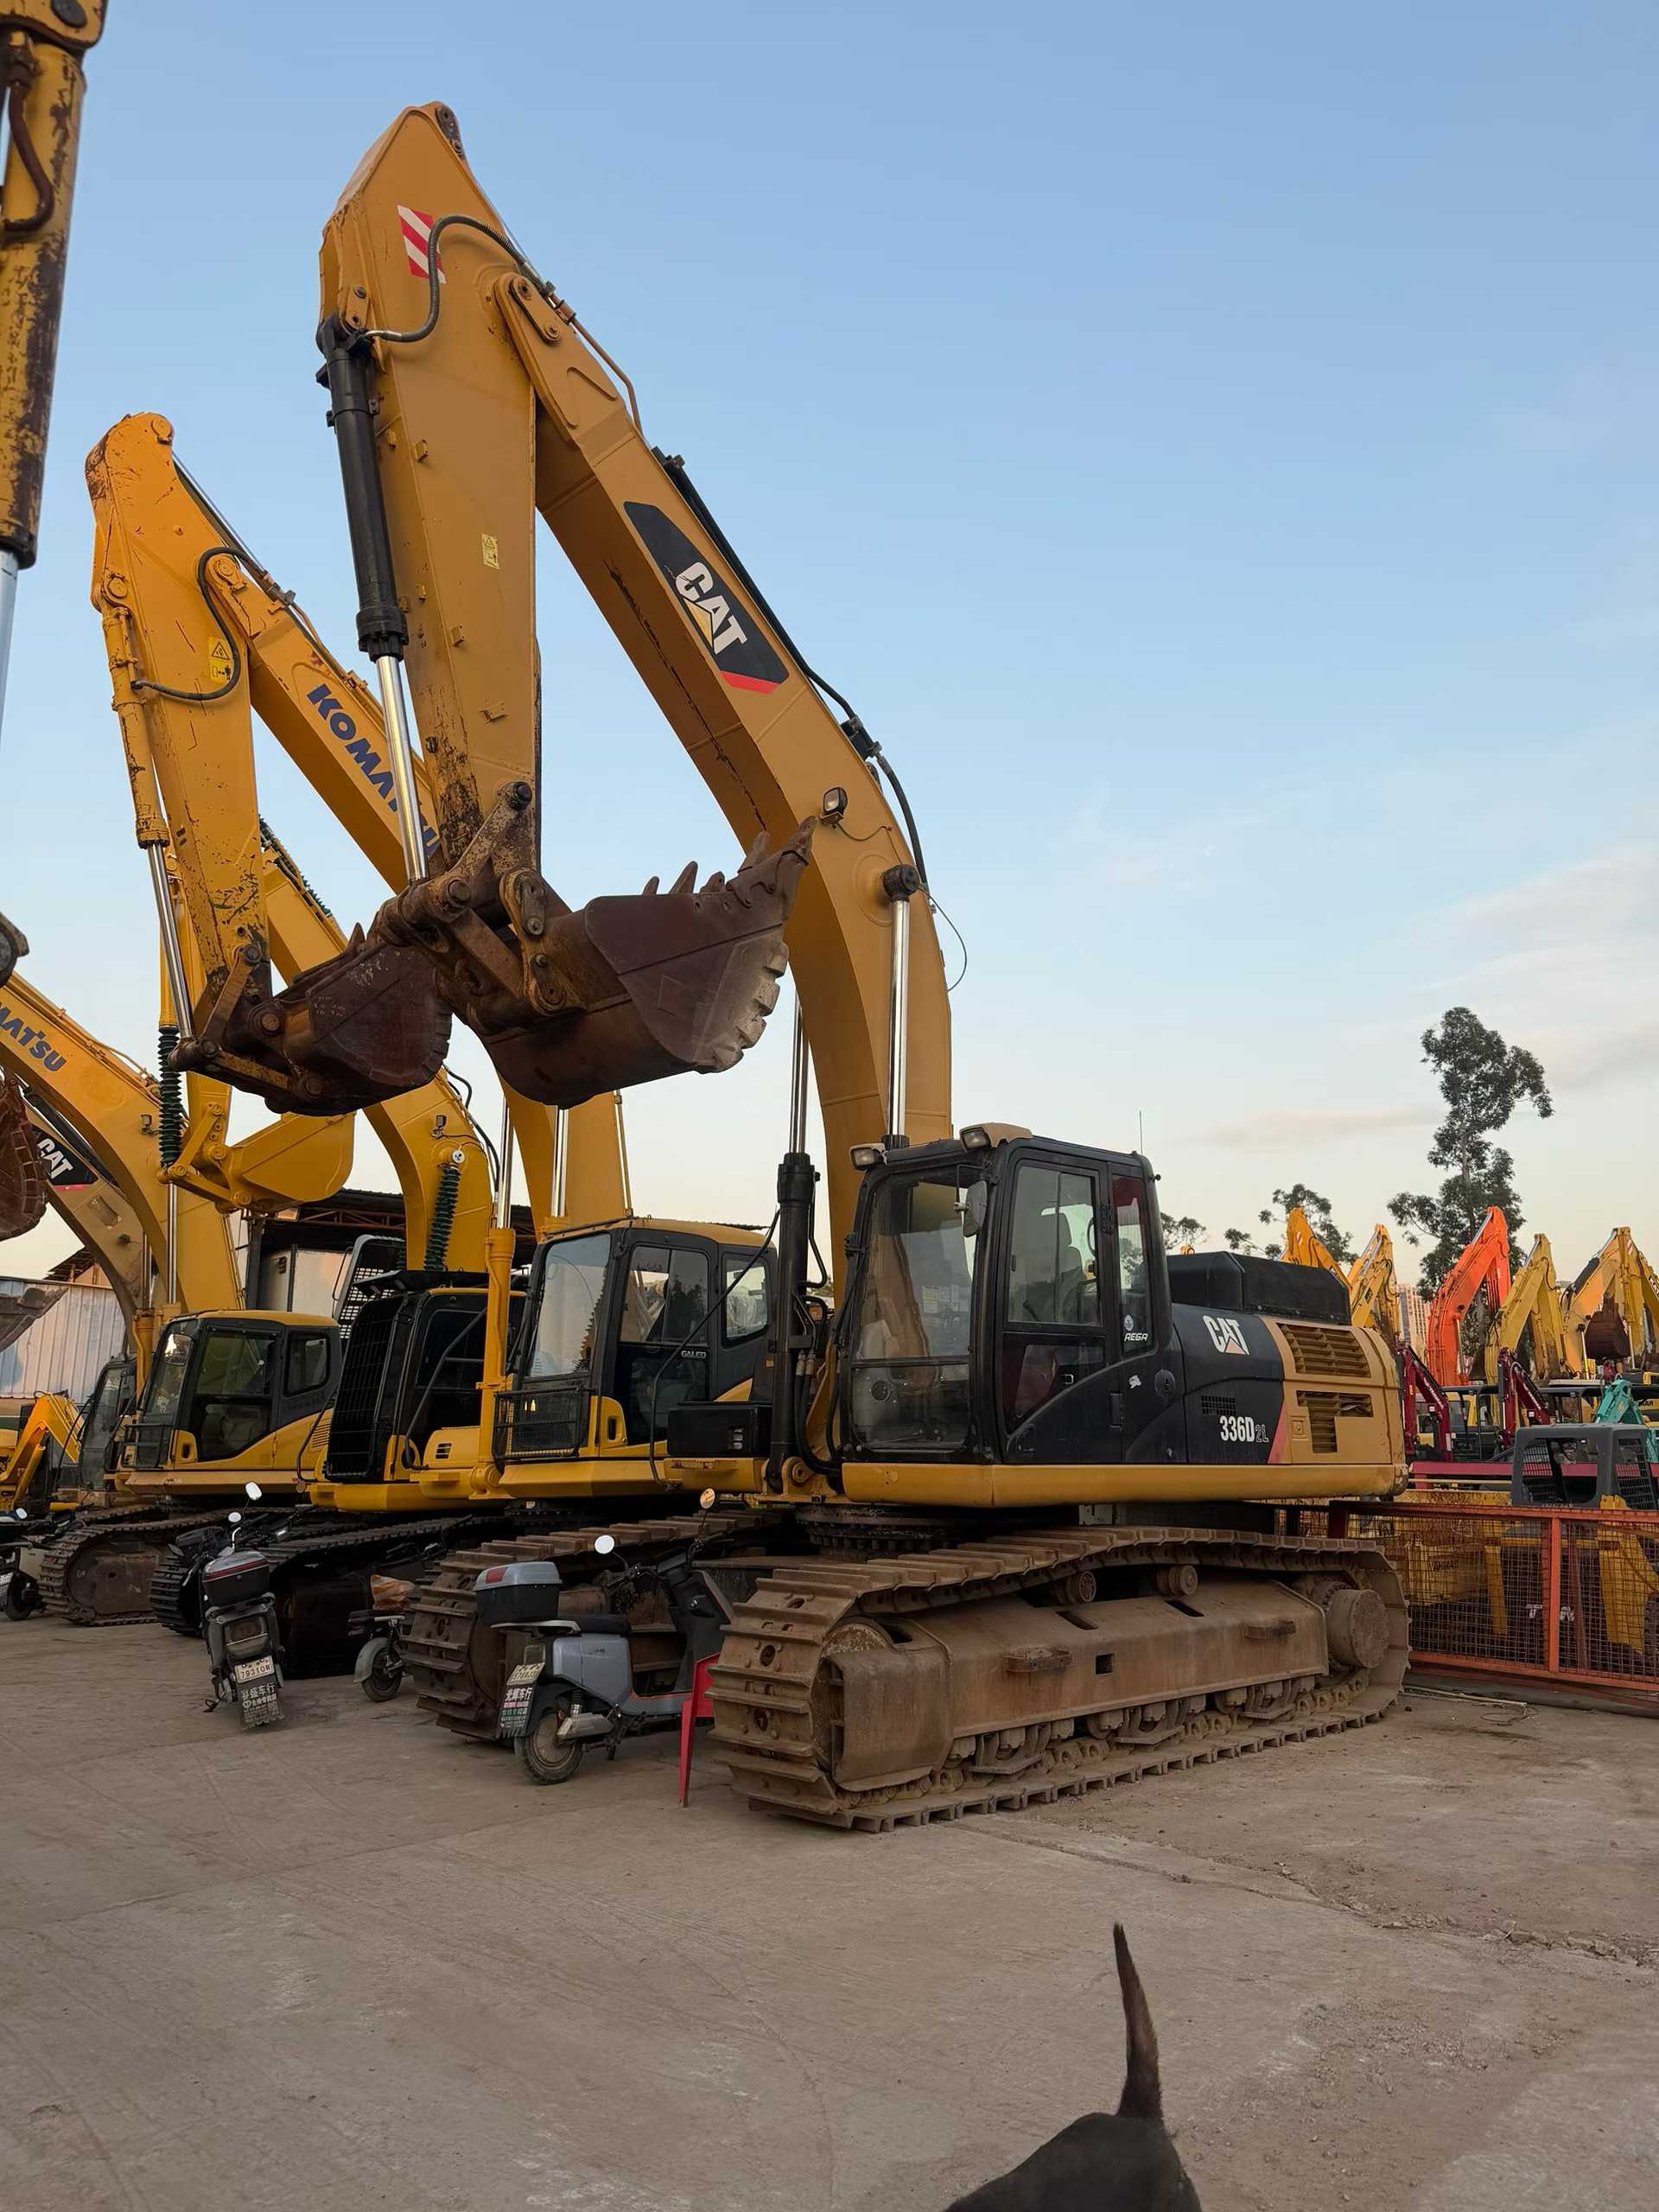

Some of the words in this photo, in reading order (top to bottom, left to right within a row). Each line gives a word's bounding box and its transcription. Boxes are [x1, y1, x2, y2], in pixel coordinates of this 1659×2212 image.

[675, 562, 748, 655] CAT
[37, 1138, 73, 1179] CAT
[1203, 1315, 1250, 1355] CAT
